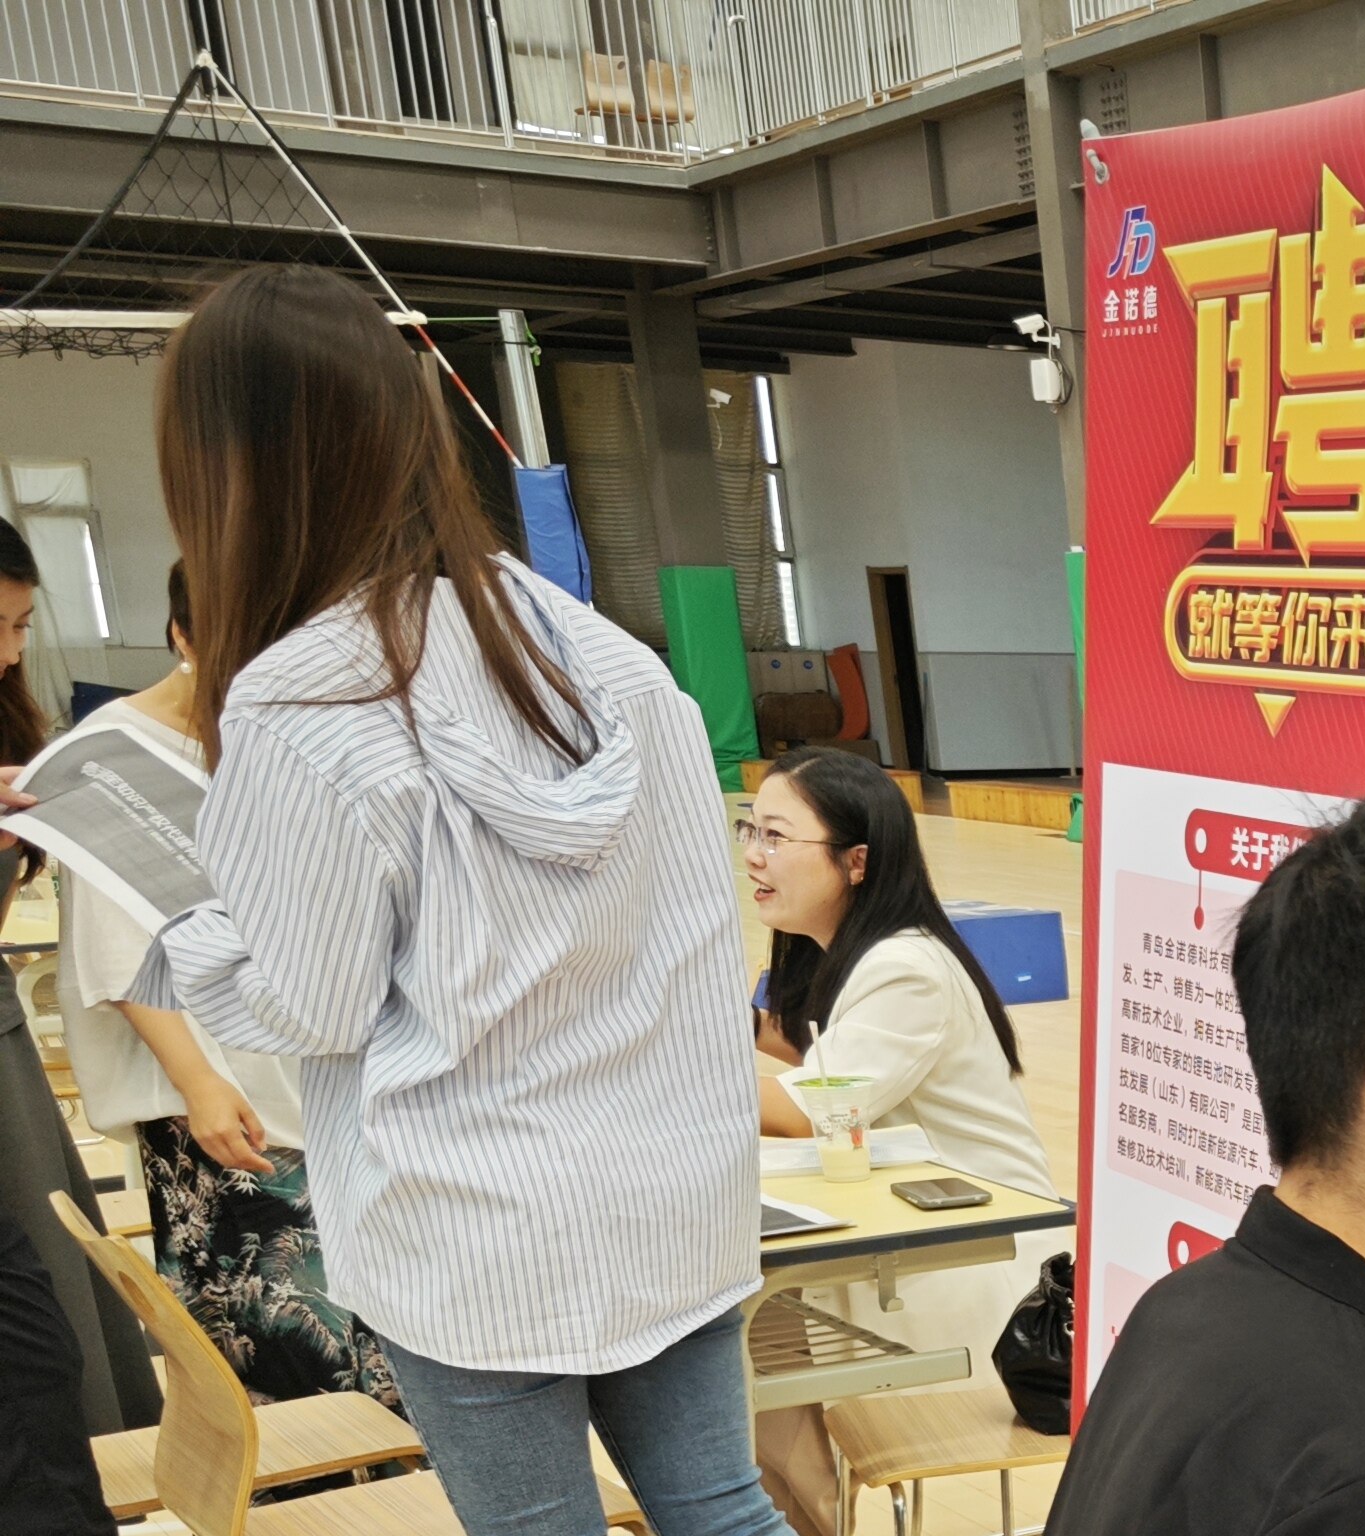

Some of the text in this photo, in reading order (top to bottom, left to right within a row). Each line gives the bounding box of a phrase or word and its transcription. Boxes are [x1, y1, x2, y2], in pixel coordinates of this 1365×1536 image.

[1103, 285, 1158, 323] 金诺德
[1142, 932, 1232, 975] 青岛金诺德科技有
[1118, 1067, 1267, 1137] 技发展（山东）有限公司”是国
